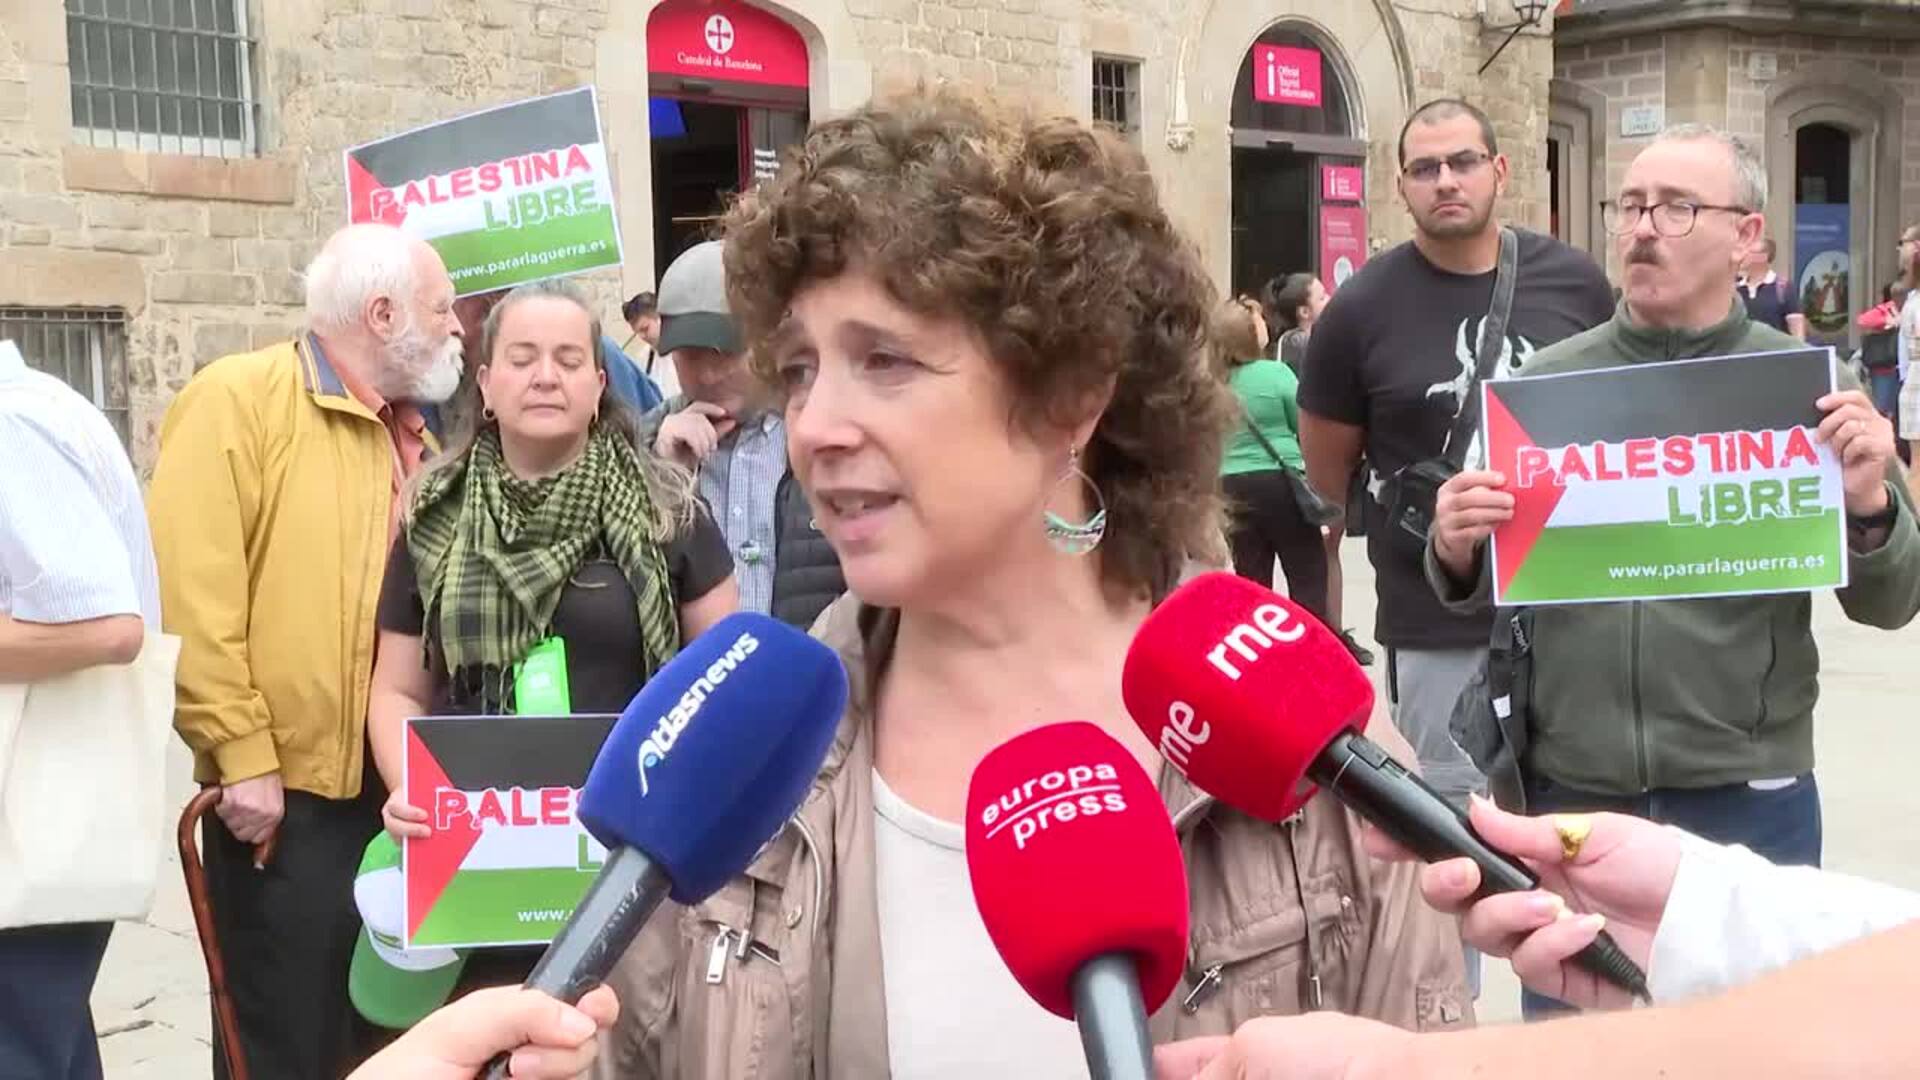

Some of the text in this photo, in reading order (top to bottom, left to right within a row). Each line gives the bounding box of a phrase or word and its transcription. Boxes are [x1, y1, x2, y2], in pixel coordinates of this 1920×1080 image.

[677, 52, 763, 72] Catedral de Barcelona
[370, 144, 594, 222] PALESTINA
[482, 180, 600, 232] LIBRE
[449, 239, 606, 281] www.pararlaguerra.es
[1516, 424, 1821, 489] PALESTINA
[1667, 475, 1826, 528] LIBRE
[1608, 553, 1826, 581] www.pararlaguerra.es
[1206, 603, 1306, 681] rne
[1157, 700, 1212, 776] rne
[981, 761, 1118, 827] europa
[1010, 789, 1127, 850] press
